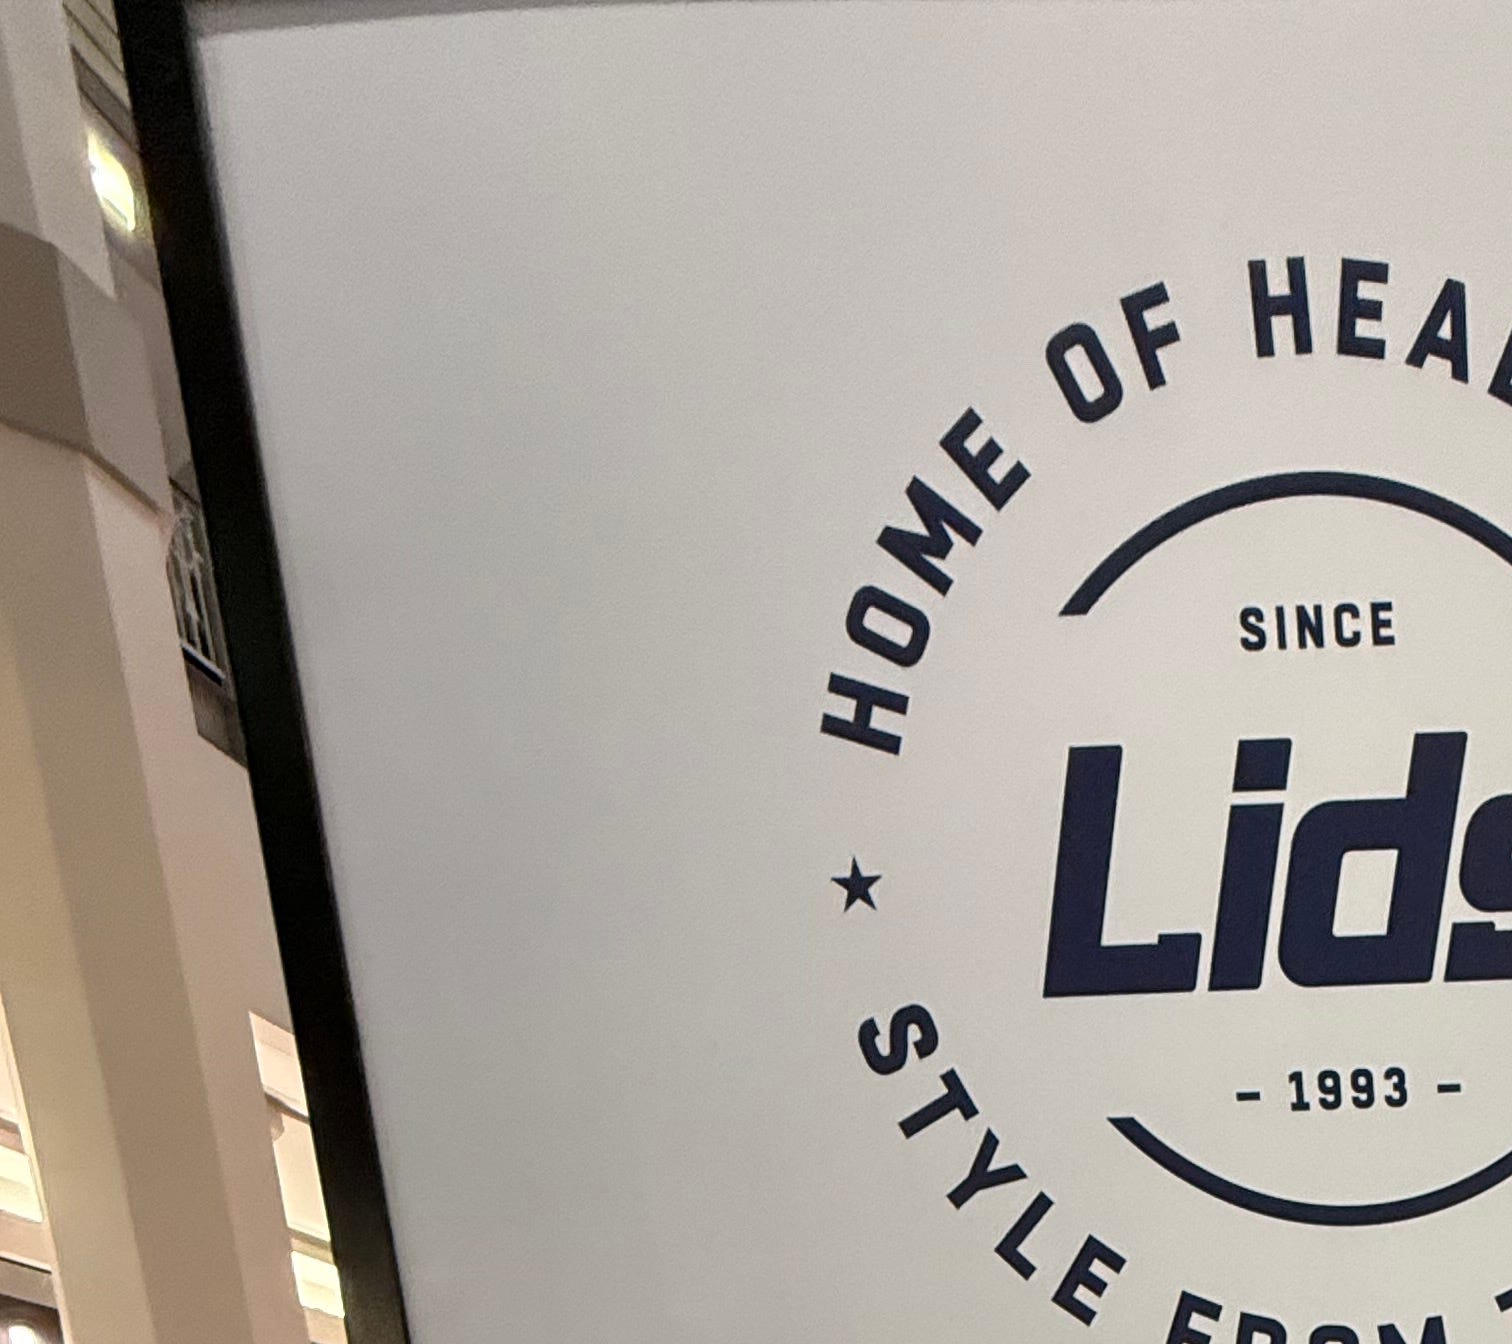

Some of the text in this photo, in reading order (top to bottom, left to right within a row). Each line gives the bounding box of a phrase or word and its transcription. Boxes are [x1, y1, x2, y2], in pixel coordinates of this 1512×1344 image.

[819, 406, 1032, 757] HOME
[1044, 280, 1182, 425] OF
[1238, 600, 1397, 653] SINCE
[856, 1003, 1128, 1328] STYLE
